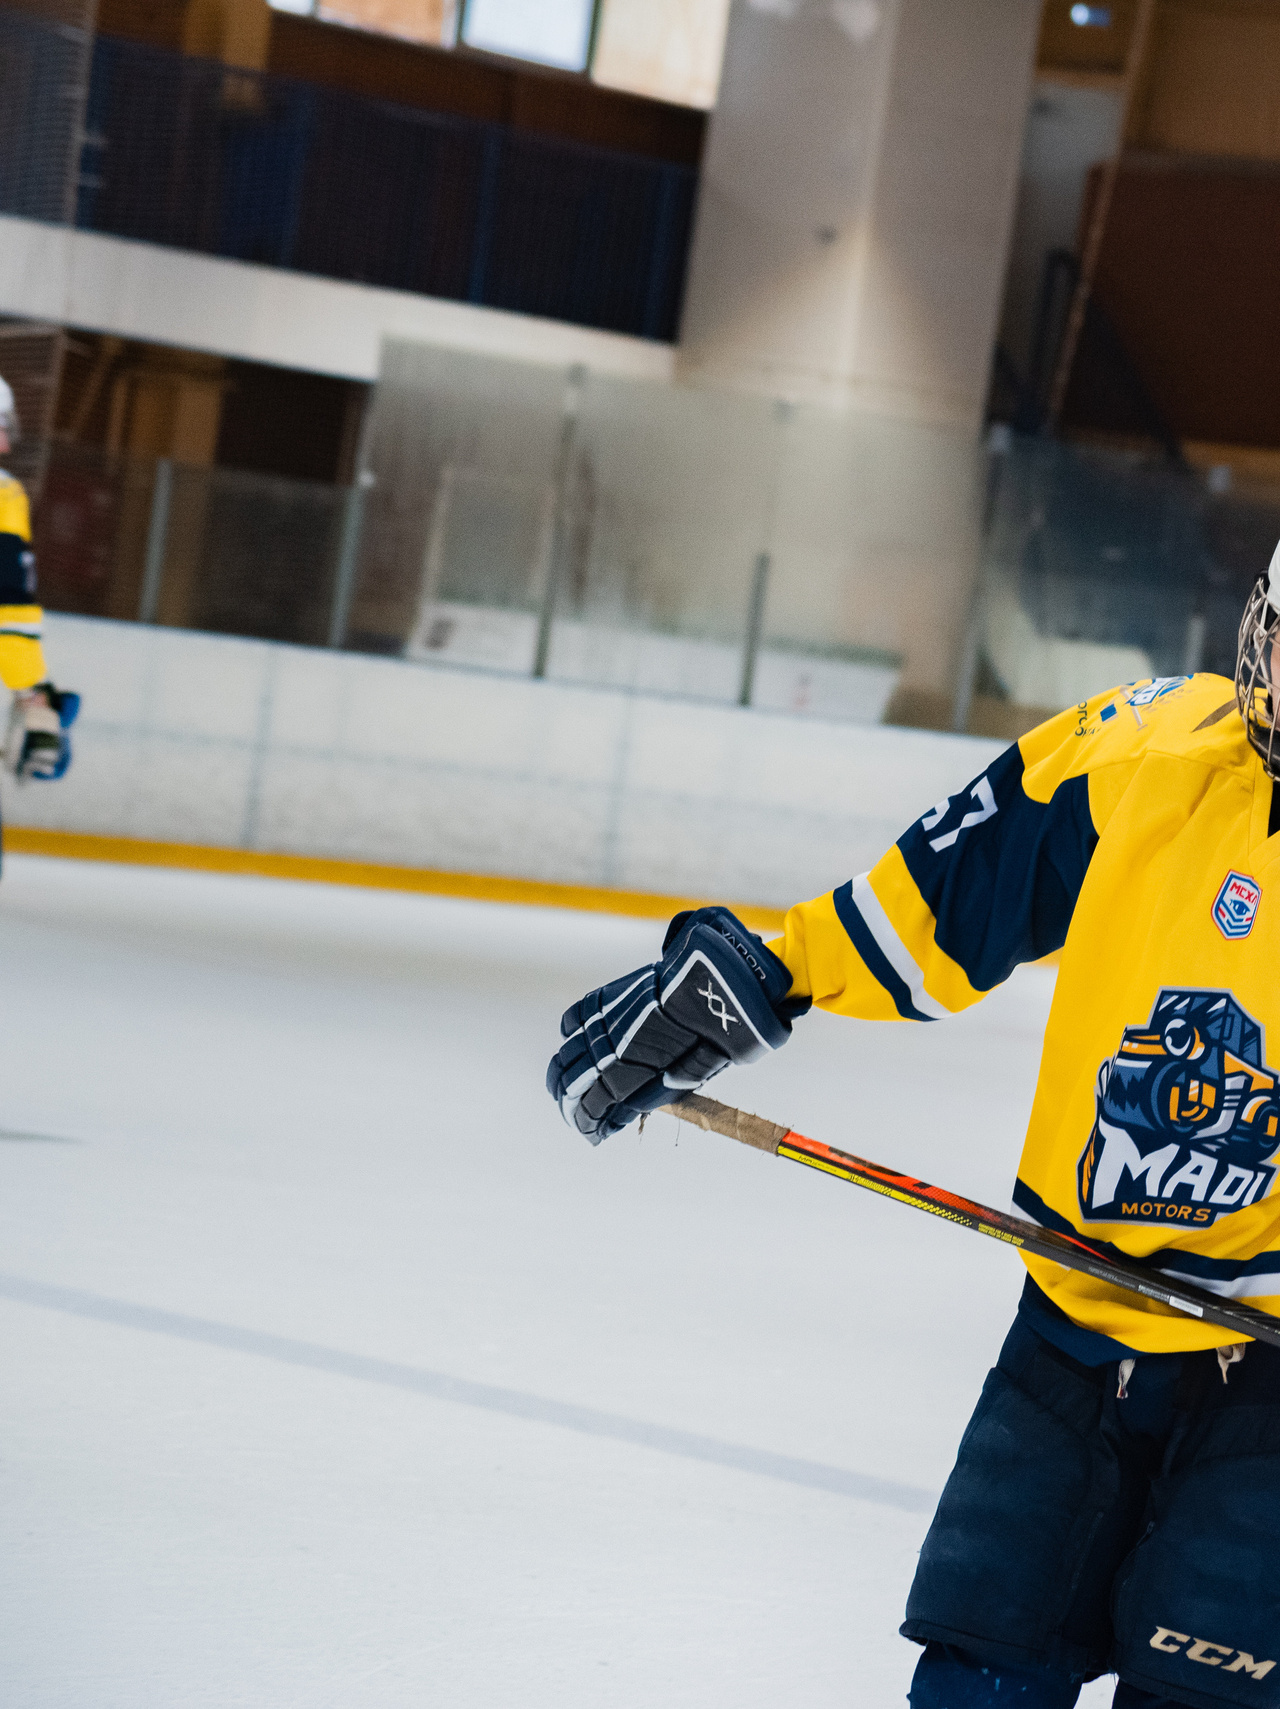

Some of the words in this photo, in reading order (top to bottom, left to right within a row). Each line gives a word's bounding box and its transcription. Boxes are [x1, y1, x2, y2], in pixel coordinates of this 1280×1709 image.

[1091, 1114, 1267, 1210] MADI
[1121, 1202, 1211, 1223] MOTORS
[1149, 1625, 1277, 1680] CCM
